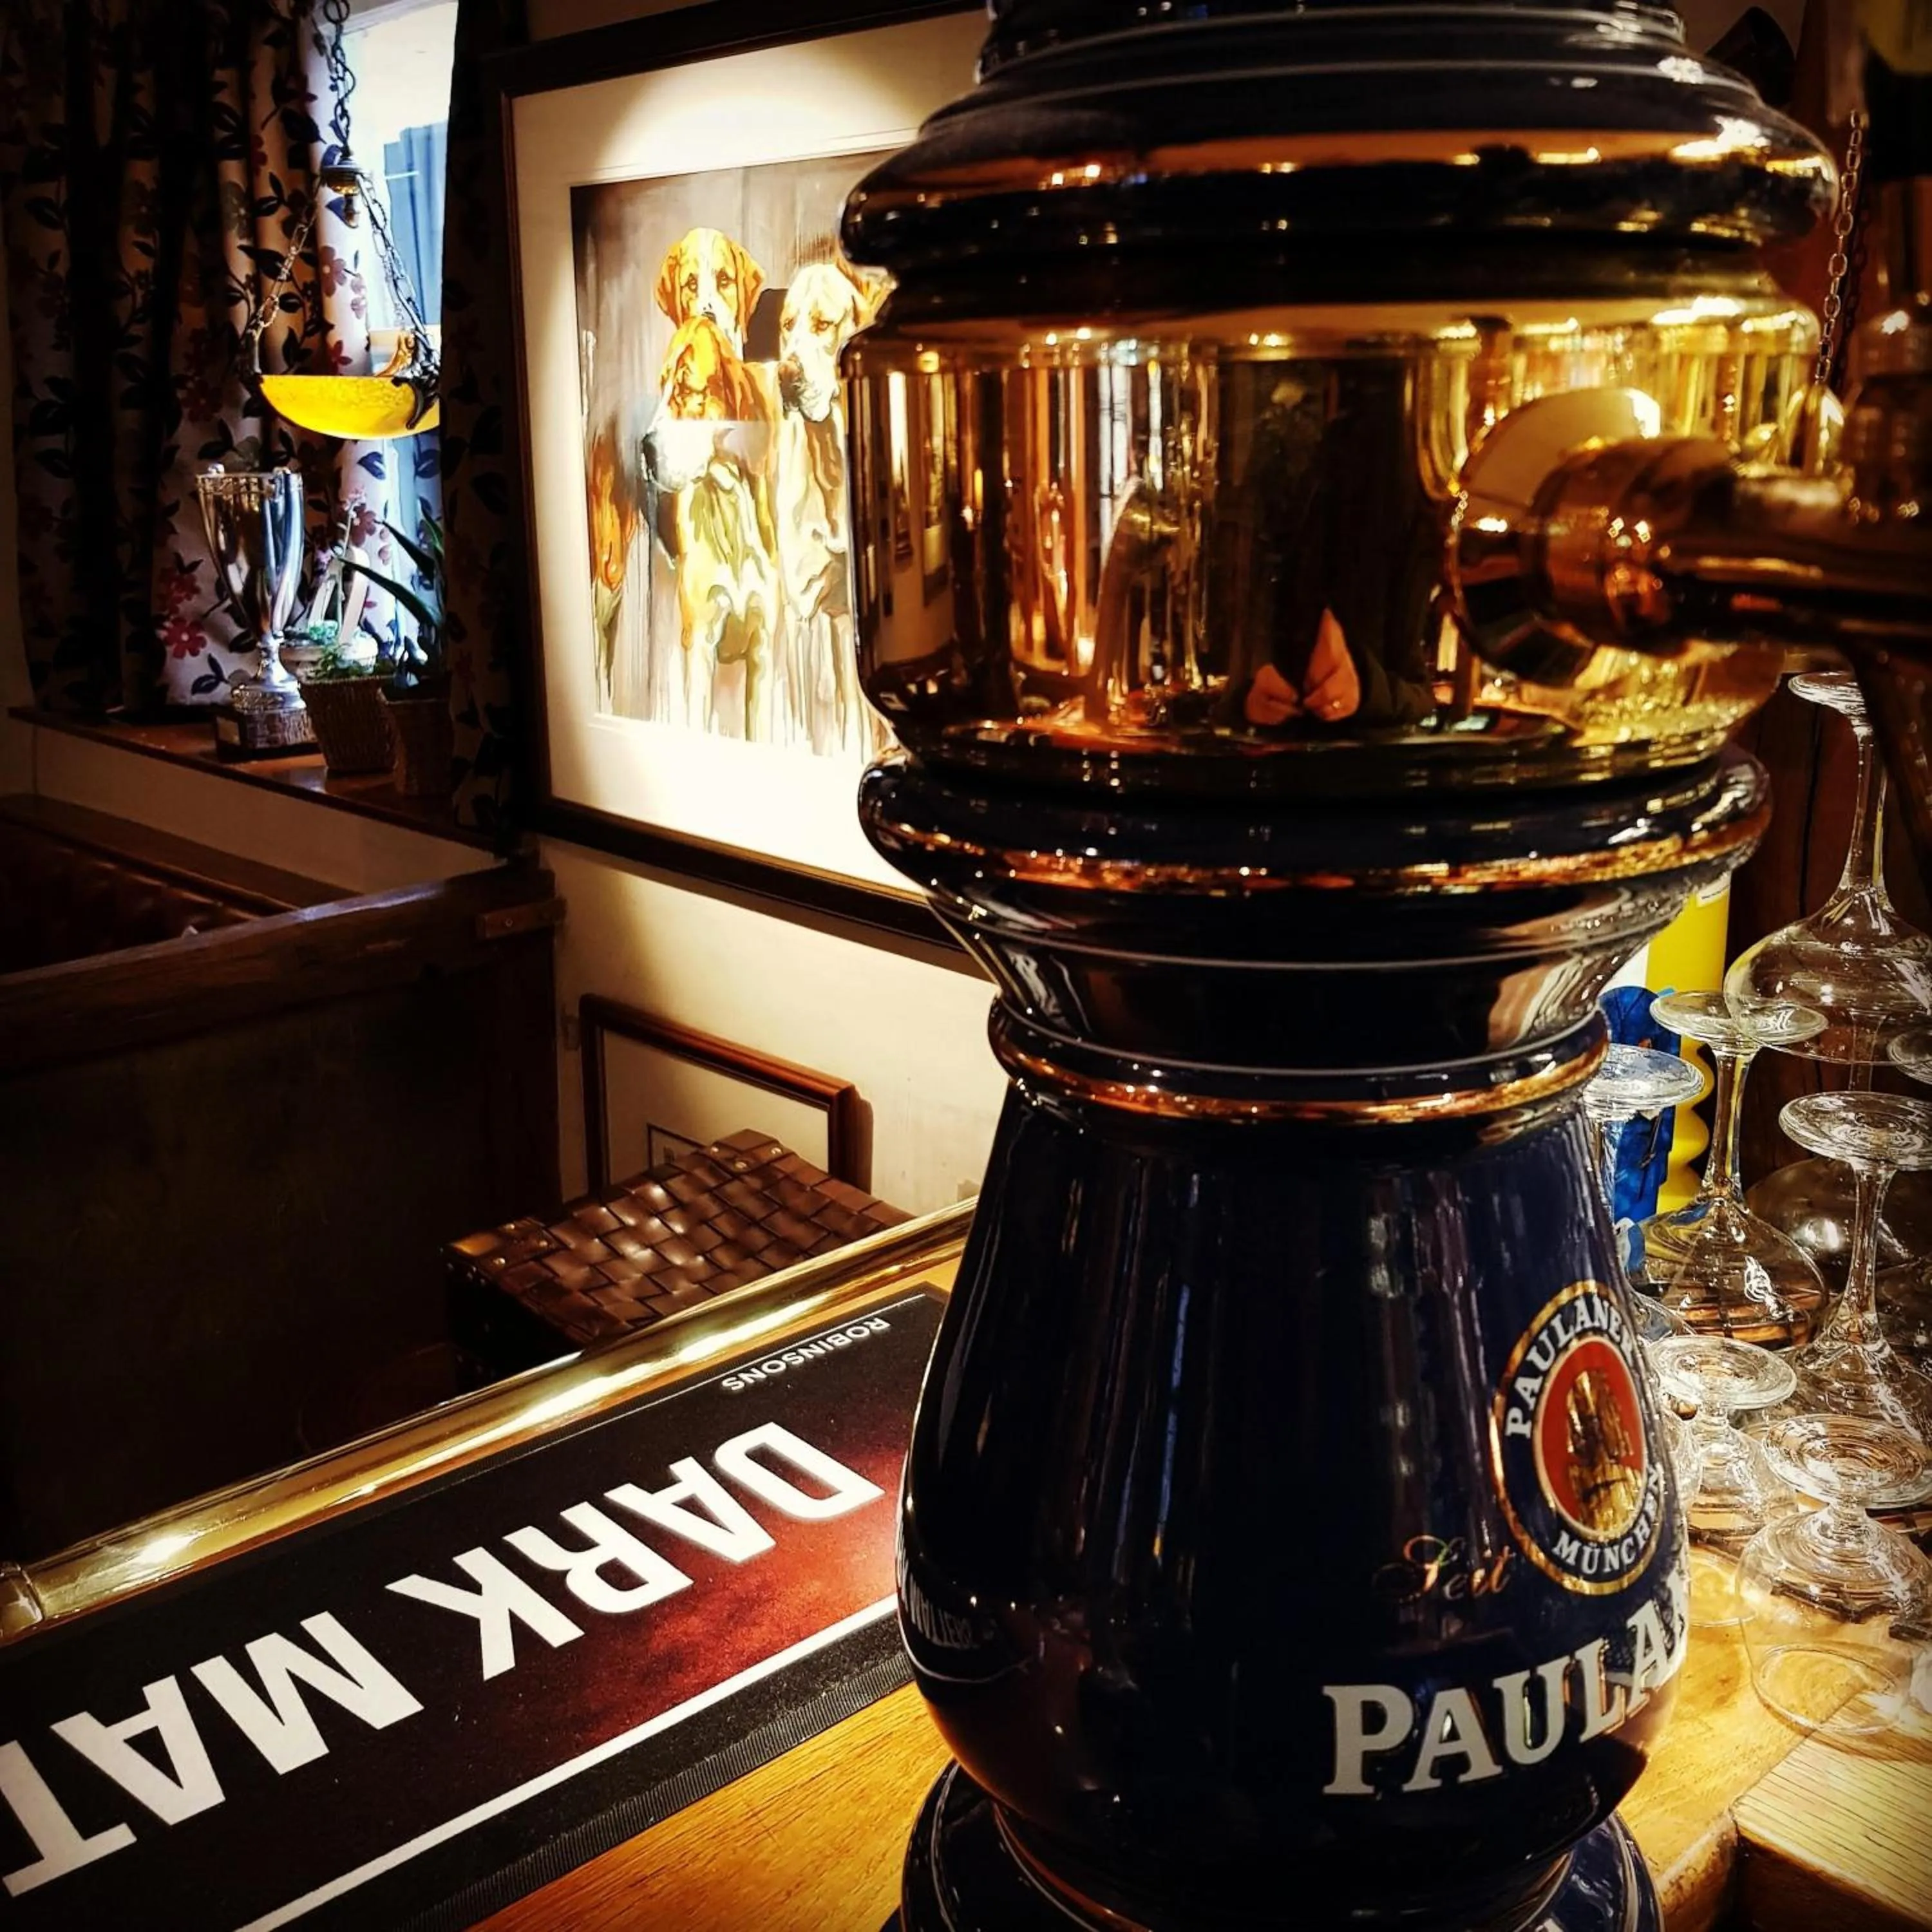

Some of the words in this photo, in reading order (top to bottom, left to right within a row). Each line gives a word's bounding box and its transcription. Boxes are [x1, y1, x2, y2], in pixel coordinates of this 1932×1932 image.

[722, 1318, 891, 1391] ROBINSONS
[1506, 1293, 1634, 1439] PAULANER
[386, 1421, 887, 1681] DARK
[0, 1611, 424, 1897] MAT
